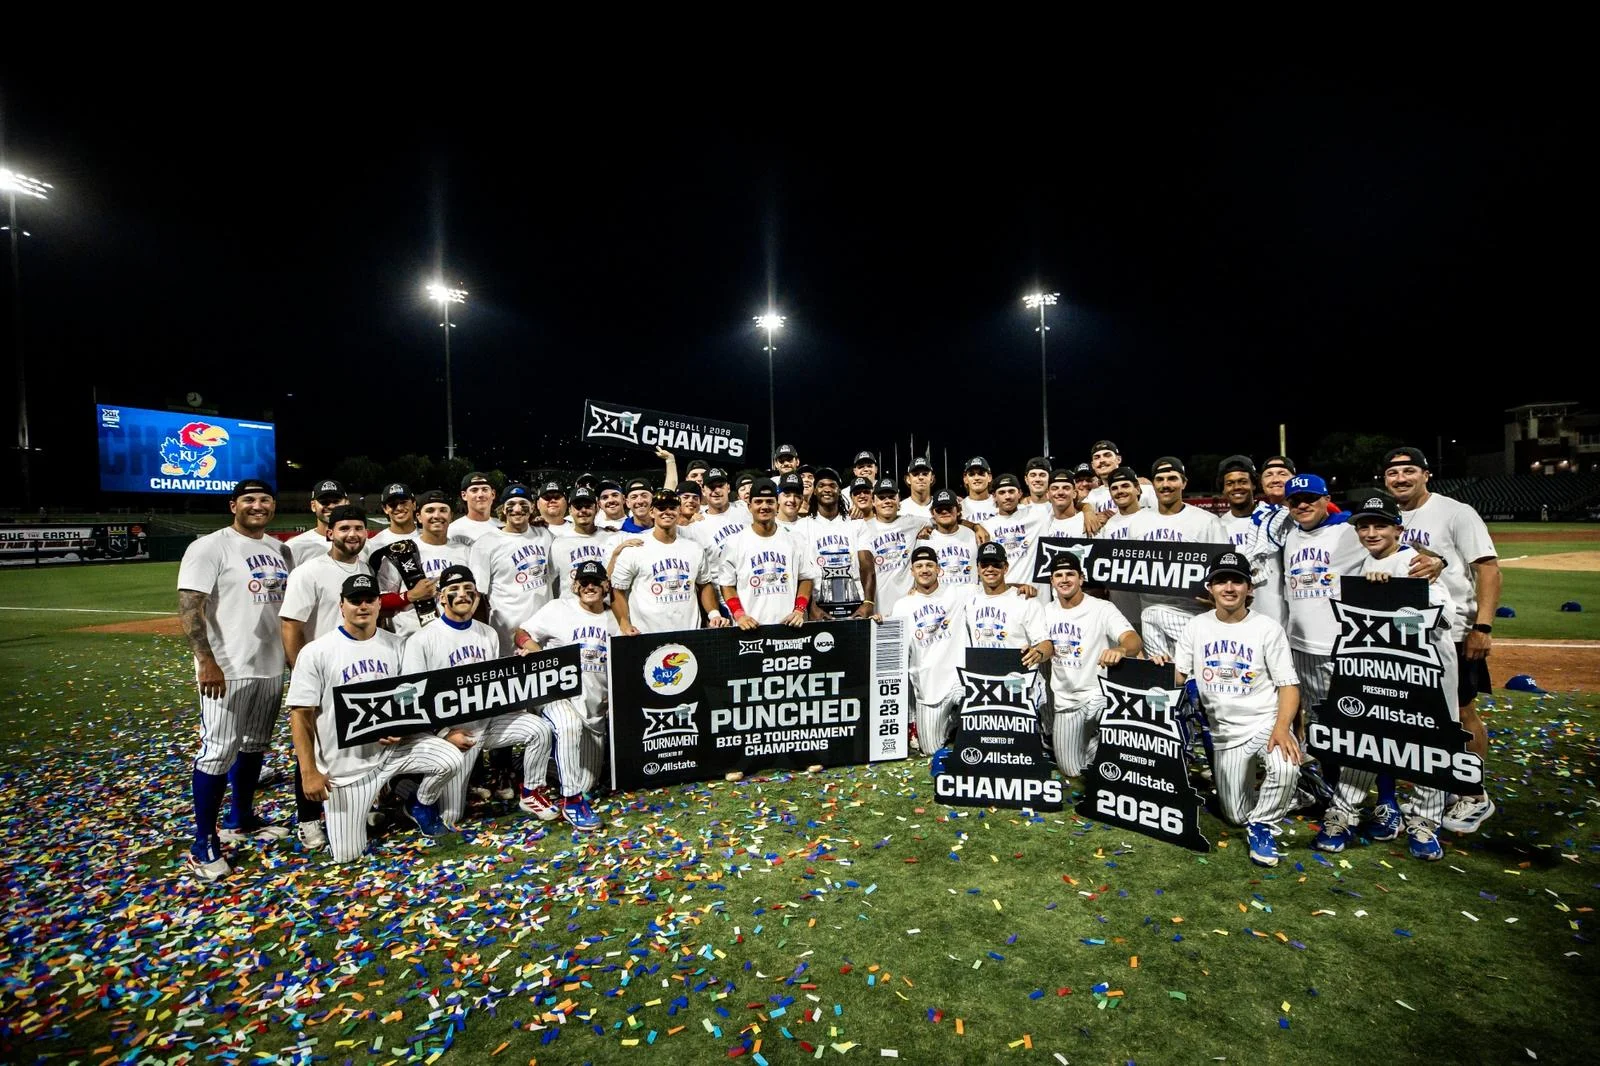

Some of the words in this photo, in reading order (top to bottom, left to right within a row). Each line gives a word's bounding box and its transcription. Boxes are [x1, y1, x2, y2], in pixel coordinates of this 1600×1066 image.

[658, 419, 700, 432] BASEBALL
[642, 425, 744, 457] CHAMPS
[180, 450, 197, 462] KU
[150, 478, 239, 491] CHAMPIONS
[1291, 477, 1309, 488] KU
[43, 531, 80, 539] EARTH
[816, 534, 849, 550] KANSAS
[873, 531, 906, 550] KANSAS
[1401, 529, 1430, 546] NSAS
[751, 551, 787, 569] KANSAS
[1112, 549, 1164, 561] BASEBALL
[1177, 552, 1207, 562] 2026
[1290, 547, 1330, 567] KANSAS
[652, 558, 690, 576] KANSAS
[1294, 588, 1334, 599] AYHAWKS
[913, 604, 946, 622] KANSAS
[976, 606, 1007, 624] KANSAS
[572, 626, 607, 641] KANSA
[766, 638, 772, 646] A
[772, 635, 812, 646] DIFFERENT
[1339, 603, 1440, 664] XII
[774, 642, 803, 652] LEAGUE
[1204, 640, 1253, 662] KANSAS
[456, 665, 518, 686] BASEBALL
[531, 657, 559, 672] 2026
[762, 655, 812, 673] 2026
[1336, 657, 1441, 689] TOURNAMENT
[661, 671, 673, 679] KU
[434, 664, 579, 720] CHAMPS
[728, 671, 846, 703] TICKET
[880, 683, 900, 696] 05
[963, 670, 1036, 715] XII
[1362, 685, 1398, 697] PRESENTED
[1399, 690, 1409, 699] BY
[345, 681, 428, 738] XII
[710, 698, 861, 734] PUNCHED
[880, 704, 899, 716] 23
[1103, 681, 1180, 737] XII
[1366, 704, 1436, 729] Allstate
[644, 703, 697, 738] XII
[880, 723, 899, 736] 26
[961, 715, 1037, 734] TOURNAMENT
[642, 734, 699, 752] TOURNAMENT
[716, 735, 742, 748] BIG
[745, 733, 762, 745] 12
[763, 725, 856, 743] TOURNAMENT
[980, 736, 1006, 744] PRESENTED
[1007, 737, 1015, 745] BY
[1101, 728, 1181, 759] TOURNAMENT
[658, 751, 677, 759] PRESENTED
[745, 739, 829, 756] CHAMPIONS
[1309, 723, 1483, 784] CHAMPS
[660, 760, 697, 772] Allstate
[982, 752, 1032, 765] Allstate
[1119, 753, 1147, 765] PRESENTED
[1147, 759, 1155, 767] BY
[936, 775, 1063, 803] CHAMPS
[1122, 770, 1175, 793] Allstate
[1096, 790, 1184, 836] 2026
